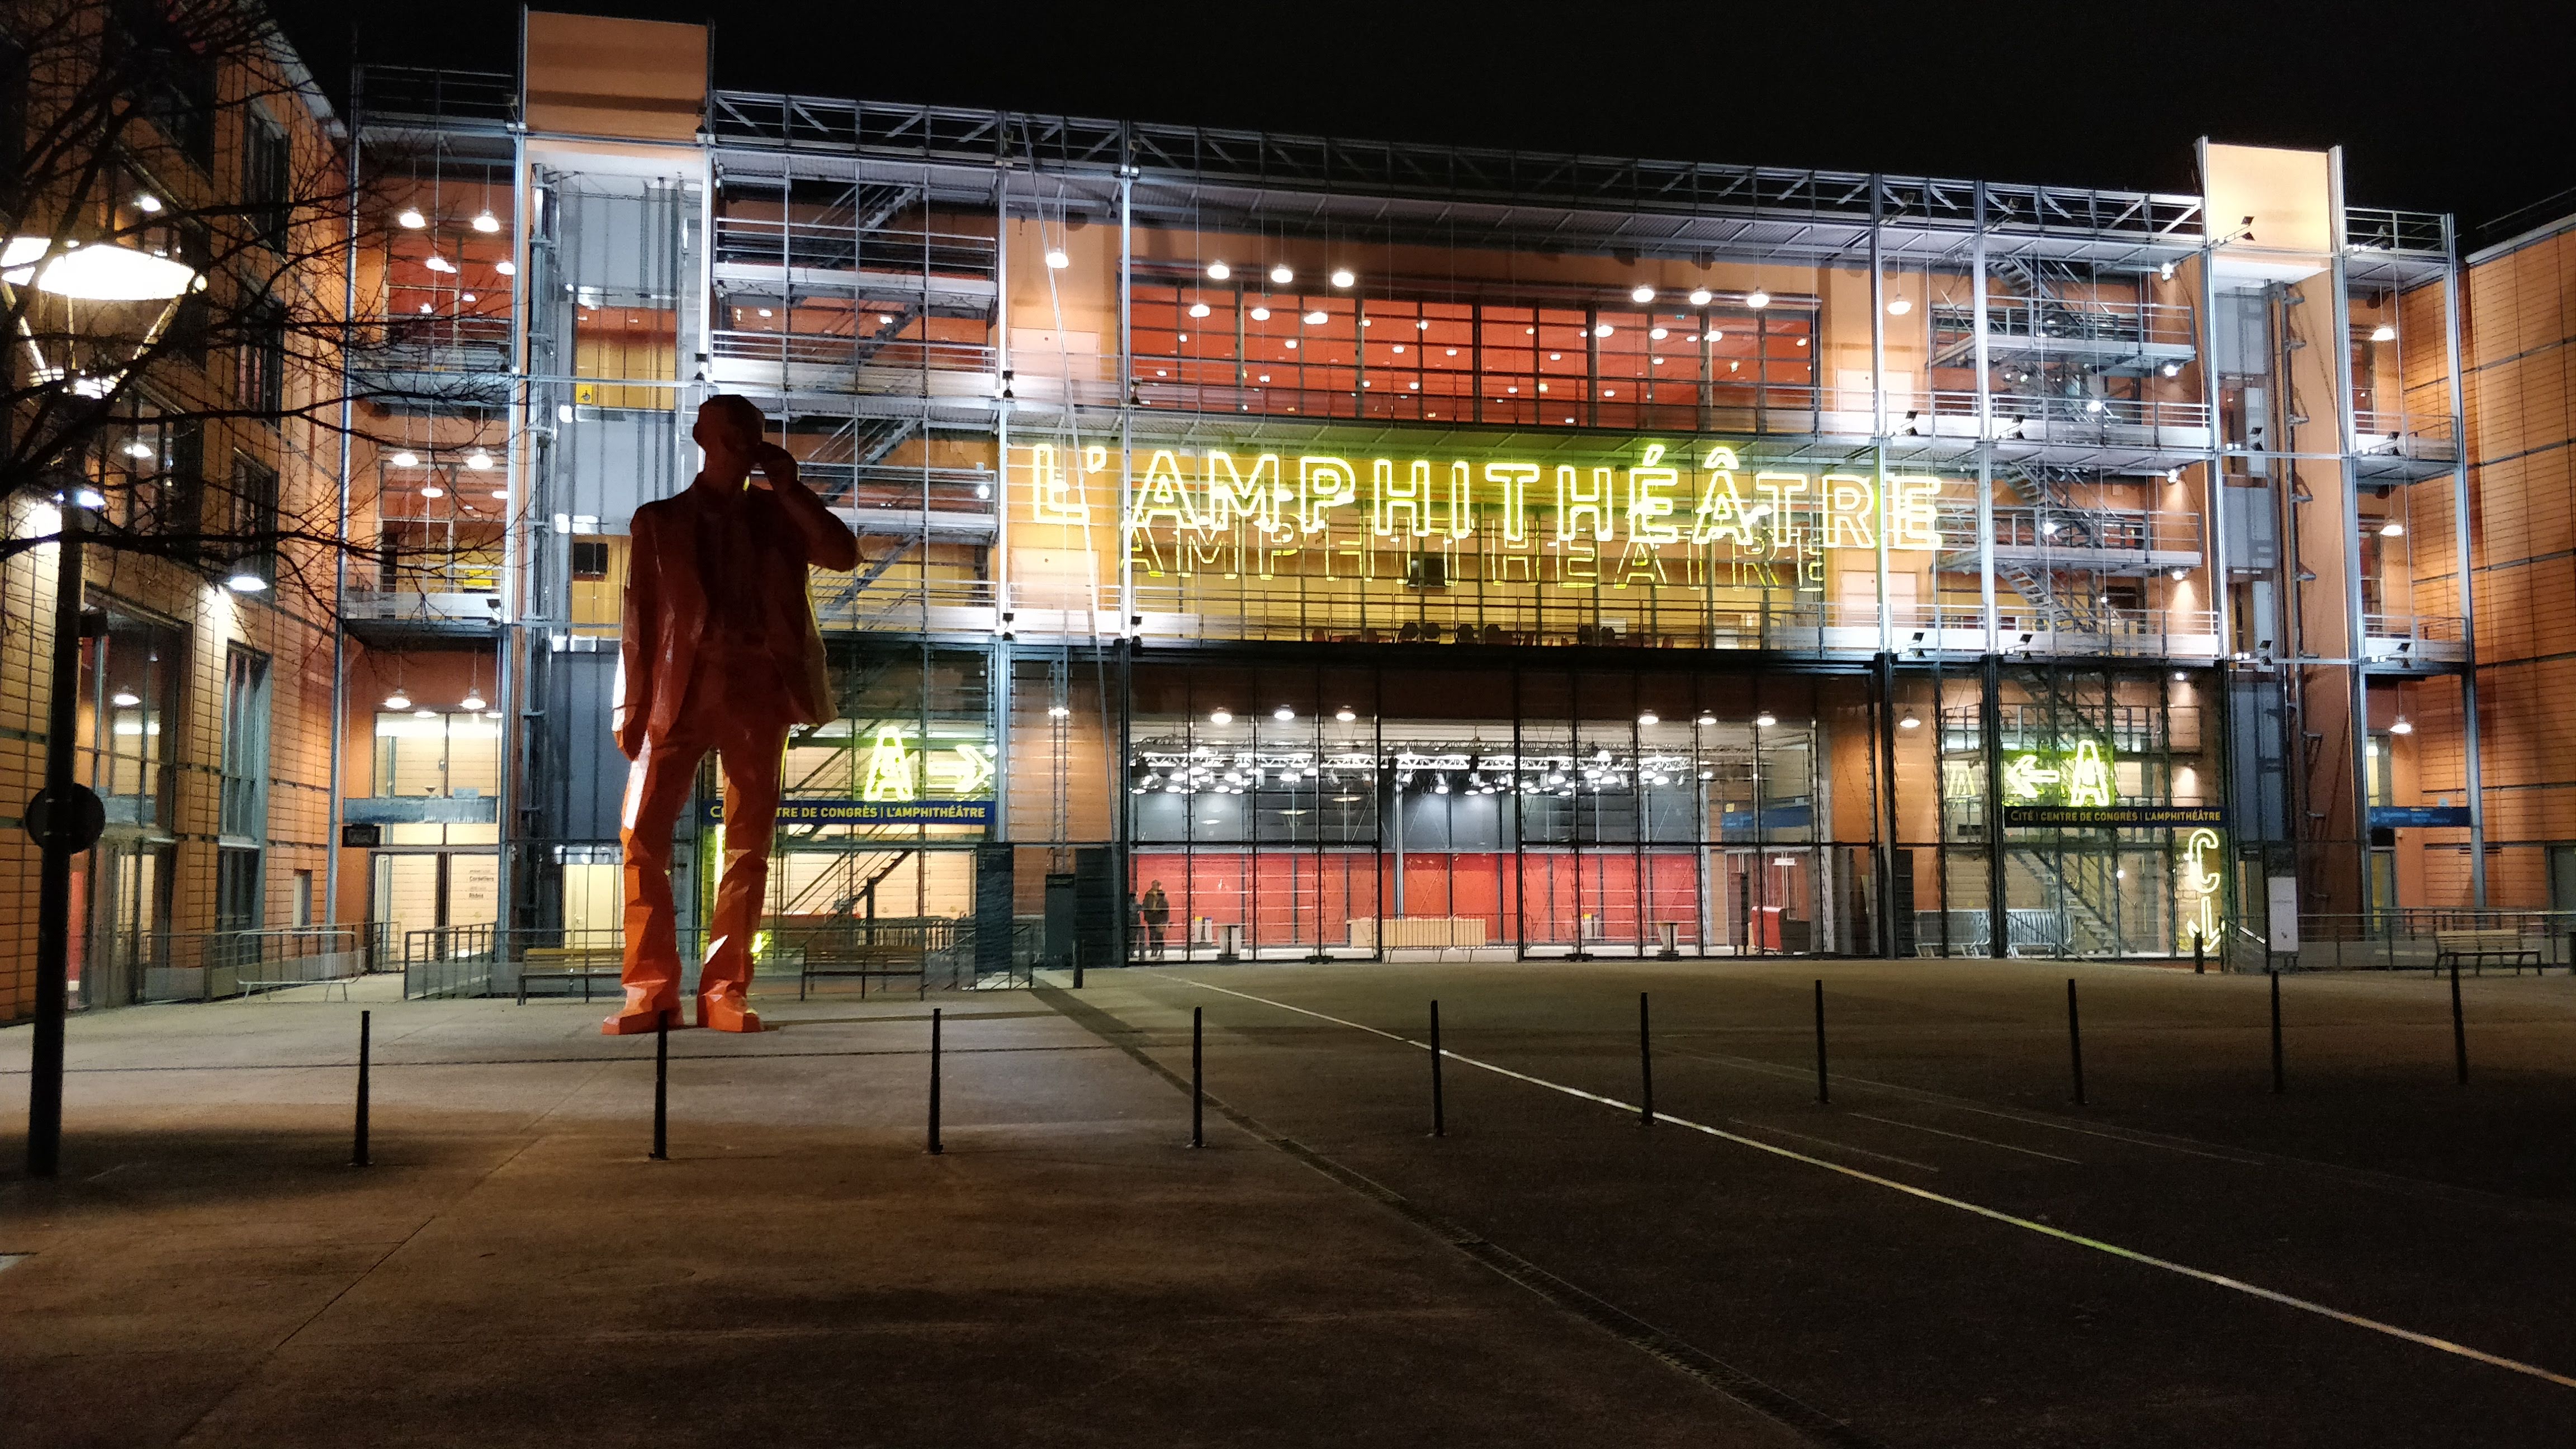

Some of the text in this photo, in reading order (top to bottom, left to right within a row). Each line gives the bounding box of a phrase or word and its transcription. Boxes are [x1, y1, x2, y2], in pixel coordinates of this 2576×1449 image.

[1032, 443, 1943, 550] L'AMPHITHÉÂTRE
[863, 726, 915, 801] A
[2071, 739, 2109, 806] A
[776, 807, 798, 818] TRE
[802, 807, 818, 818] DE
[887, 804, 986, 818] L'AMPHITHÉÂTRE
[2041, 811, 2078, 822] CENTRE
[2080, 811, 2092, 822] DE
